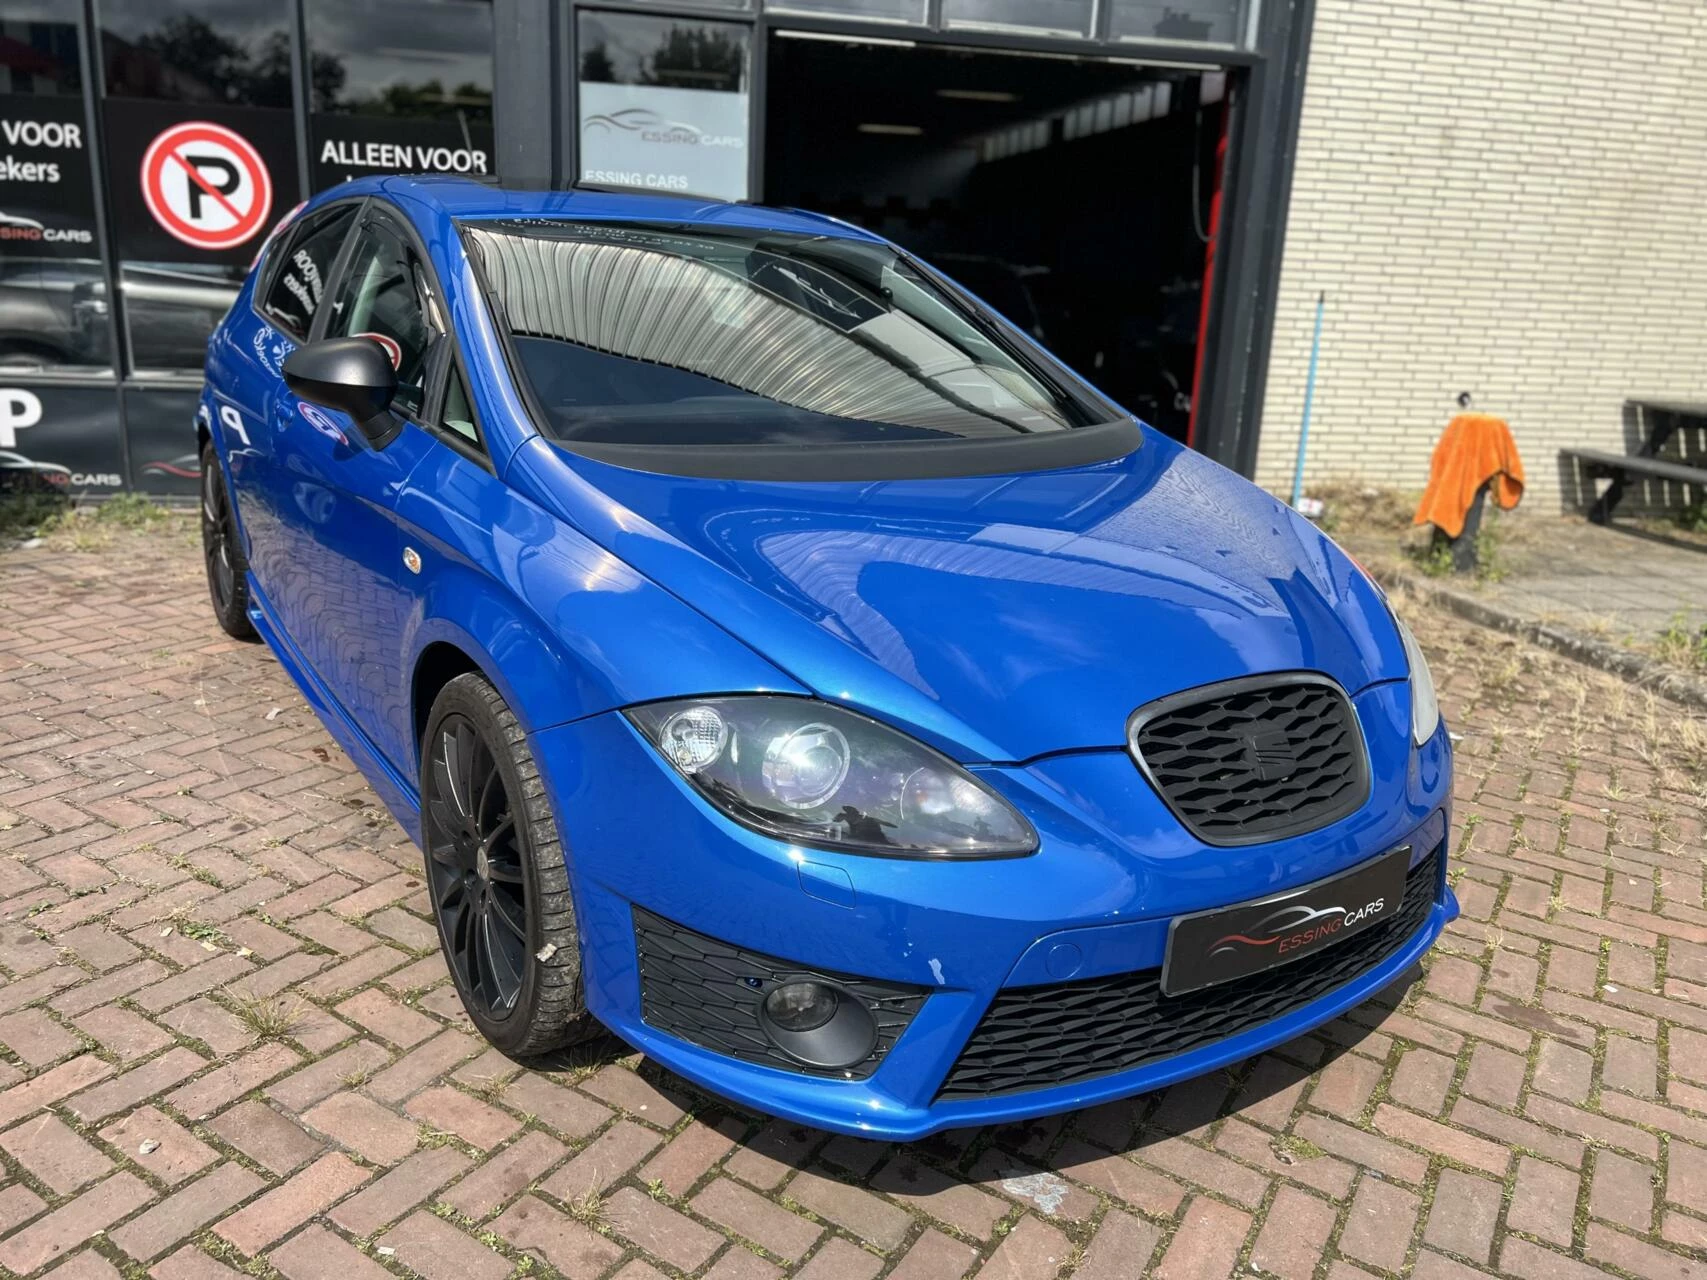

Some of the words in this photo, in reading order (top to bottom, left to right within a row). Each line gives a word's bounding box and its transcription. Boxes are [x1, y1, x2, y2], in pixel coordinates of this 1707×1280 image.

[1, 119, 82, 149] VOOR
[641, 130, 700, 145] ESSING
[701, 134, 744, 149] CARS
[320, 139, 413, 169] ALLEEN
[415, 147, 487, 175] VOOR
[584, 169, 642, 187] ESSING
[646, 173, 689, 190] CARS
[43, 228, 93, 243] CARS
[71, 473, 122, 486] CARS
[1278, 918, 1343, 954] ESSING
[1344, 897, 1385, 927] CARS
